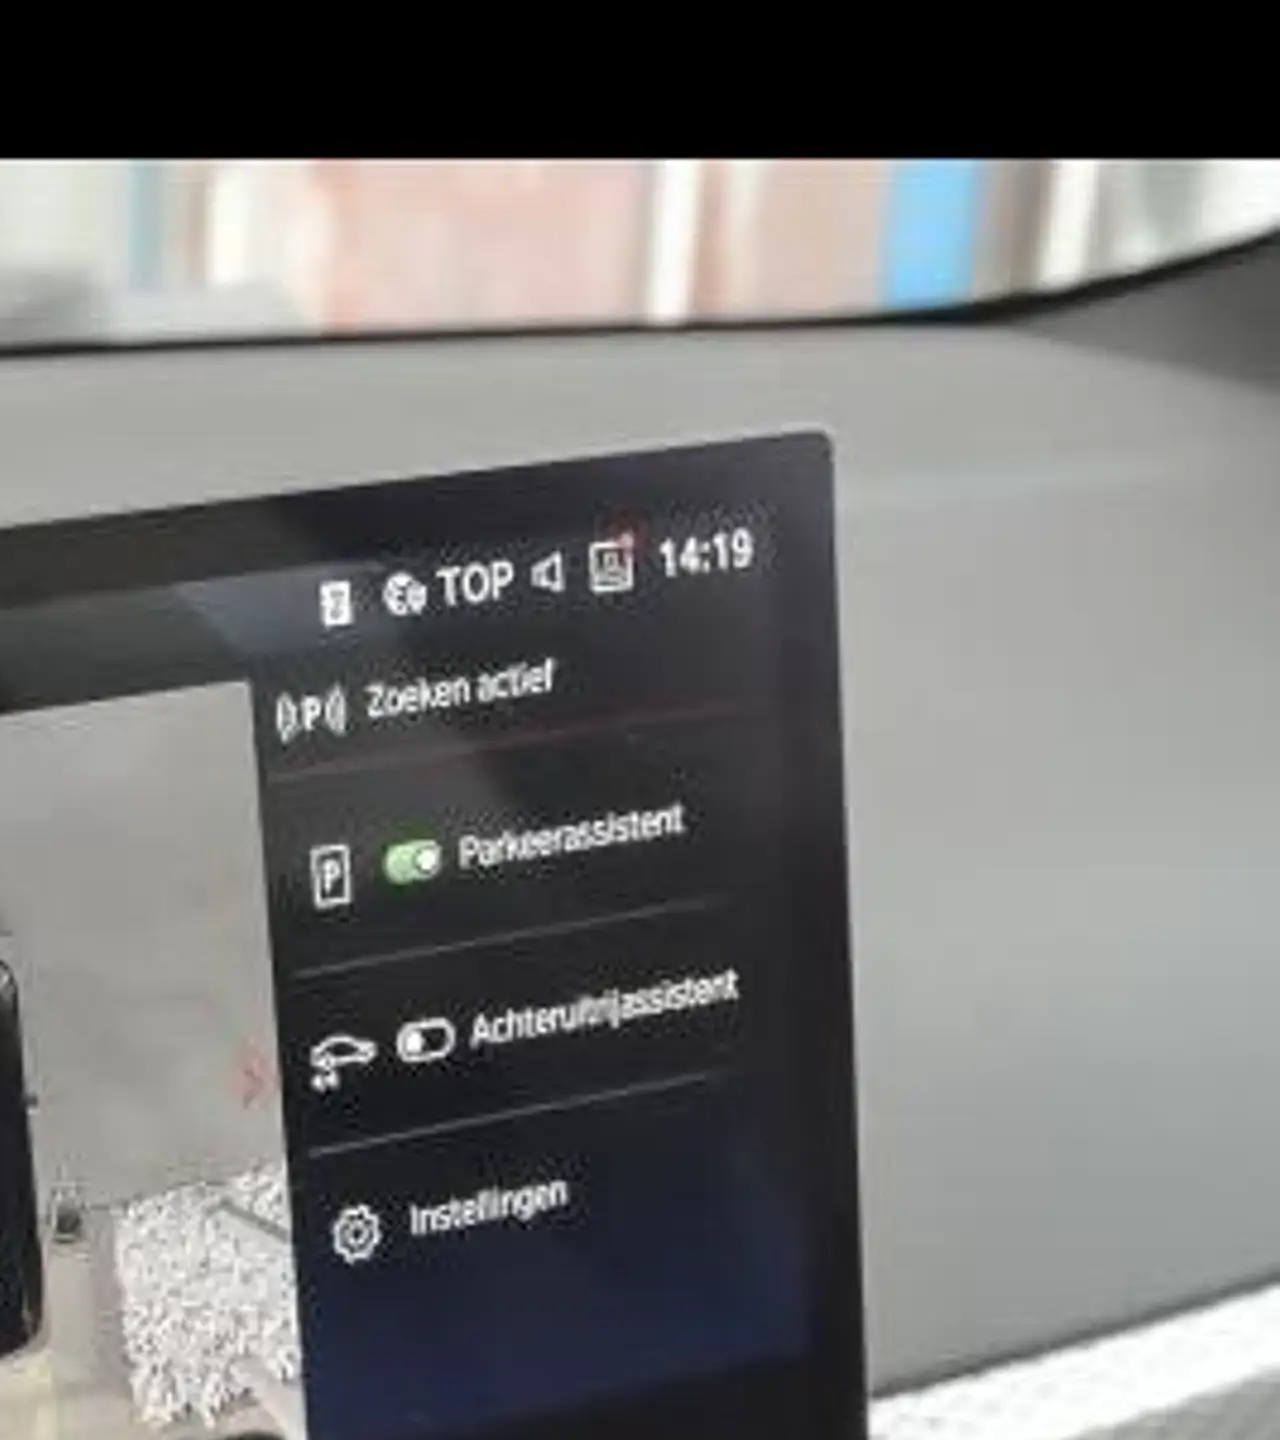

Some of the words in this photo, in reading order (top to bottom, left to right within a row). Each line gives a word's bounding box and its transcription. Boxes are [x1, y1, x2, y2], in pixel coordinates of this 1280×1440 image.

[660, 527, 755, 579] 14:19
[436, 560, 515, 606] TOP
[366, 674, 472, 720] Zoeken
[476, 656, 557, 701] actief
[458, 800, 687, 870] Parkeerassistent
[410, 1179, 570, 1236] Instellingen
